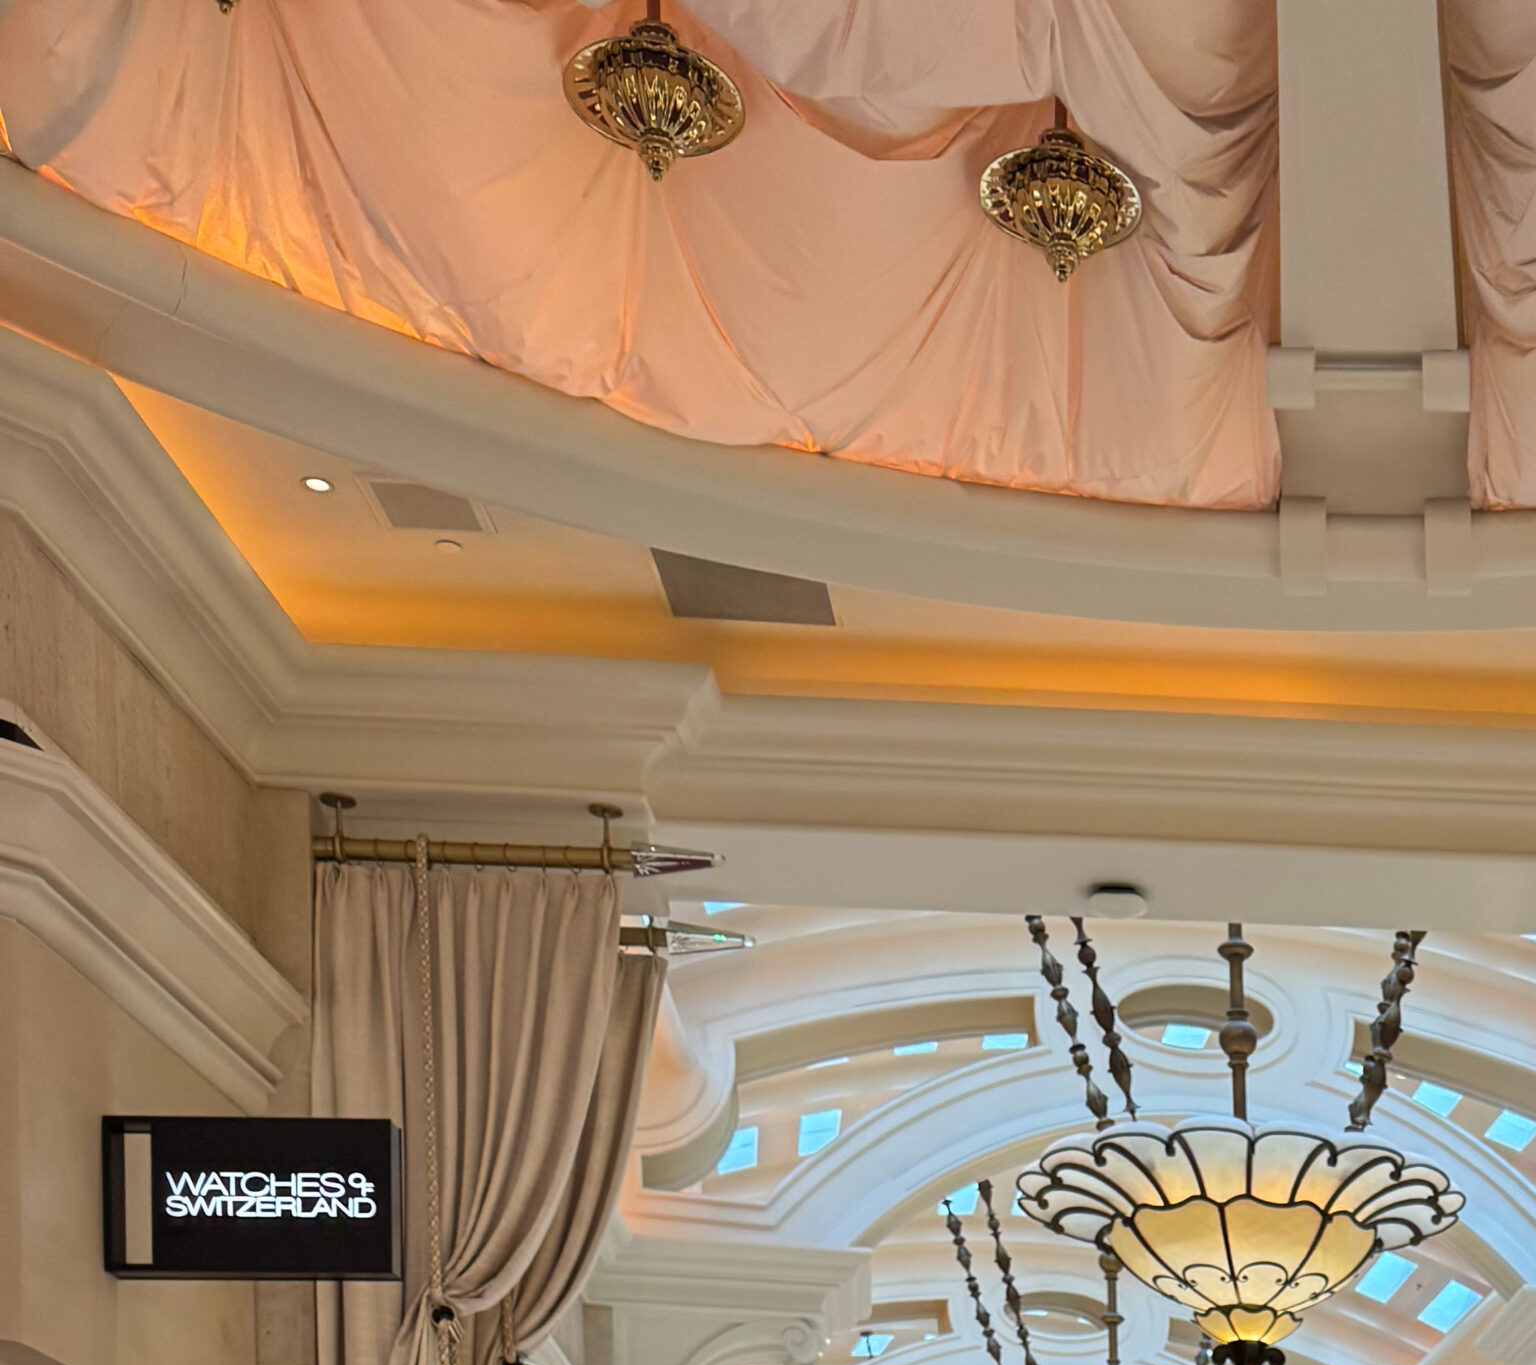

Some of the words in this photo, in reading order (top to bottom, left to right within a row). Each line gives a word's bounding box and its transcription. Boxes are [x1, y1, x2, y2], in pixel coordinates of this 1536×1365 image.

[165, 1171, 346, 1198] WATCHES
[347, 1172, 376, 1198] OF
[165, 1196, 378, 1219] SWITZERLAND
